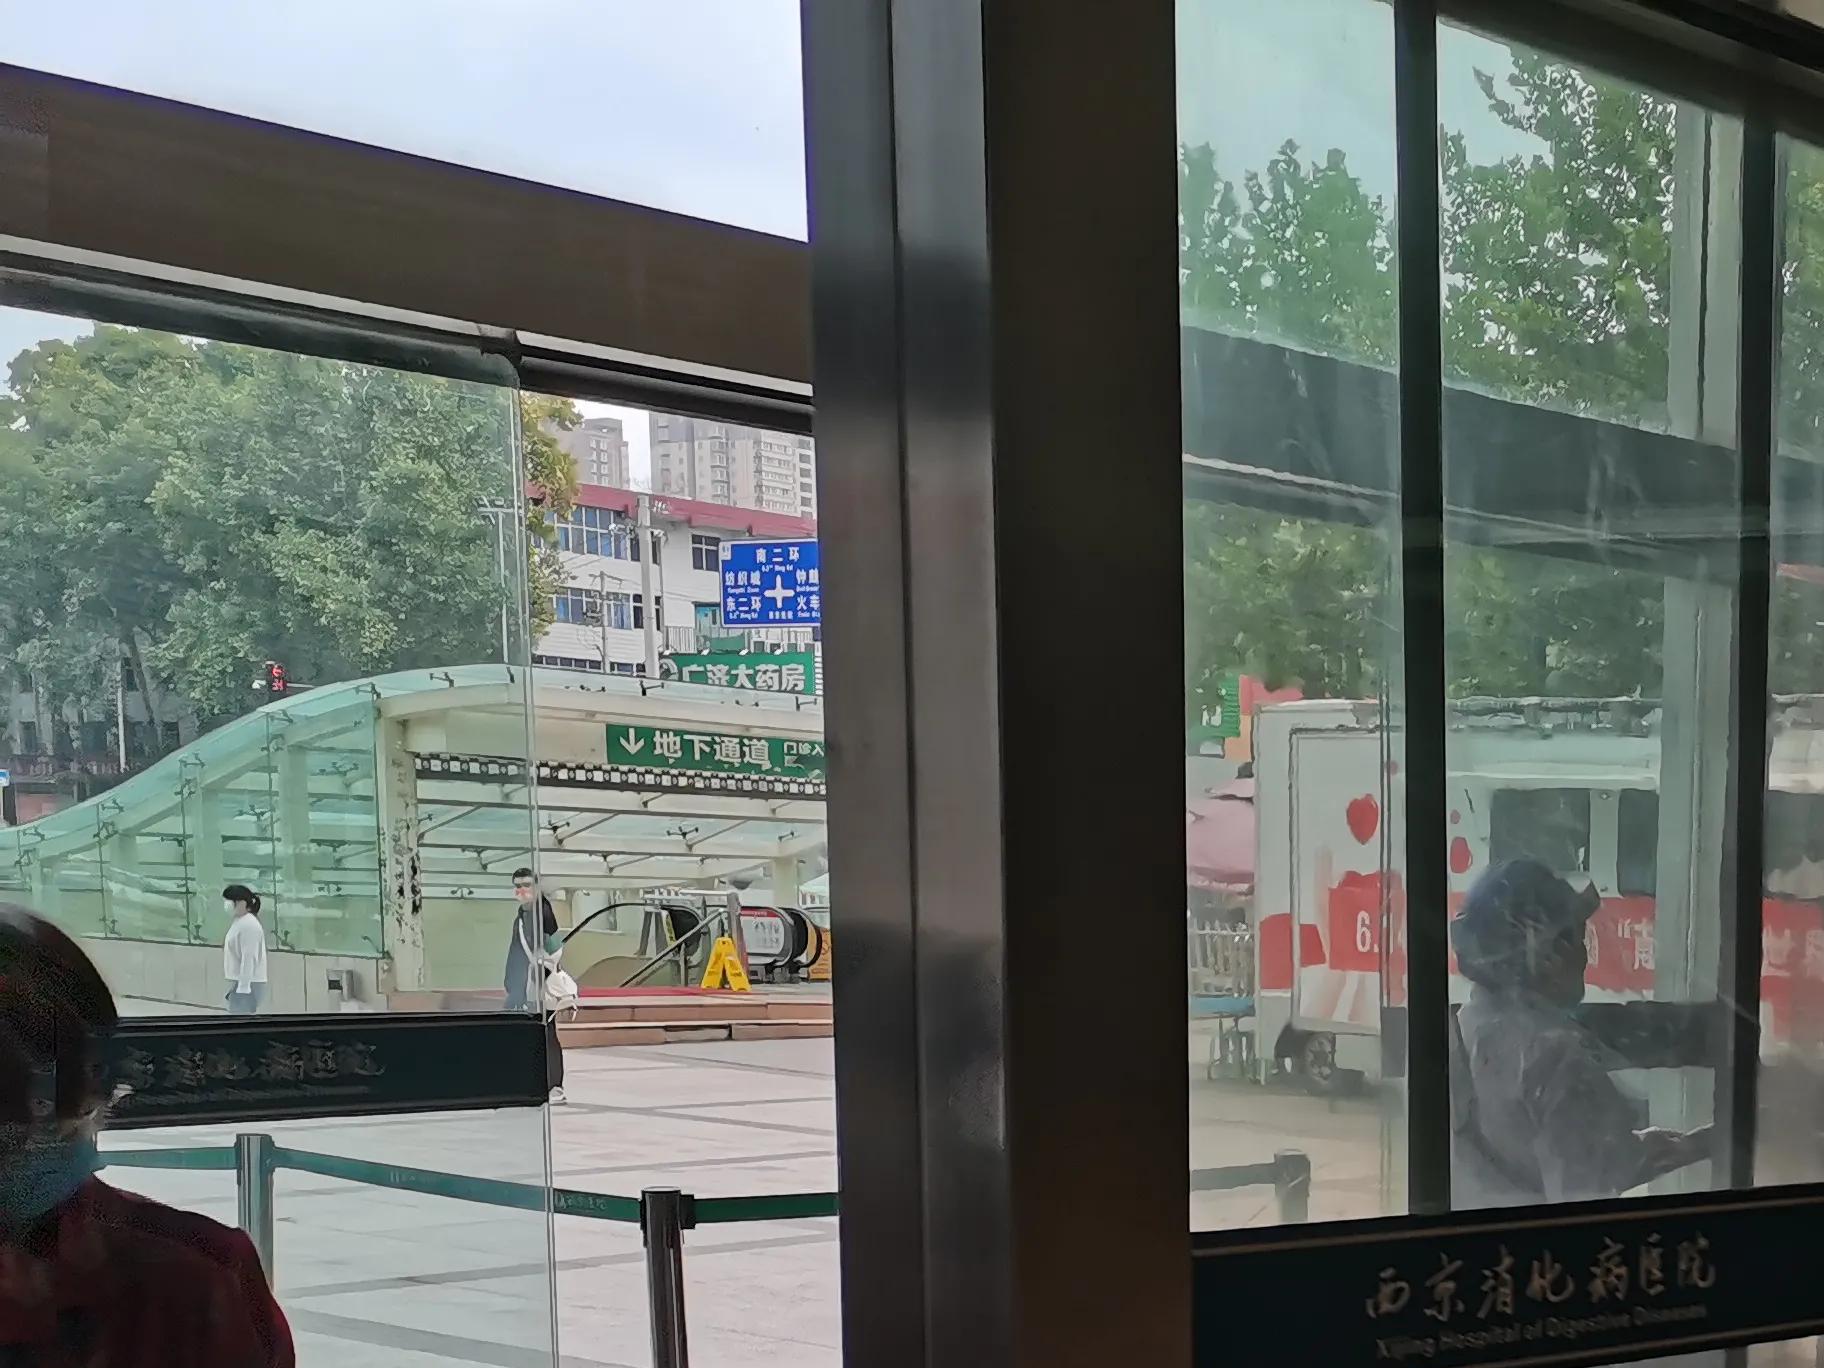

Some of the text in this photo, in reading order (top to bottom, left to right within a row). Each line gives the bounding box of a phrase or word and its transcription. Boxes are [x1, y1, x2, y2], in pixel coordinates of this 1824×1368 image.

[726, 595, 762, 612] 东二环
[681, 663, 805, 692] 广济大药房
[652, 729, 773, 770] 地下通道
